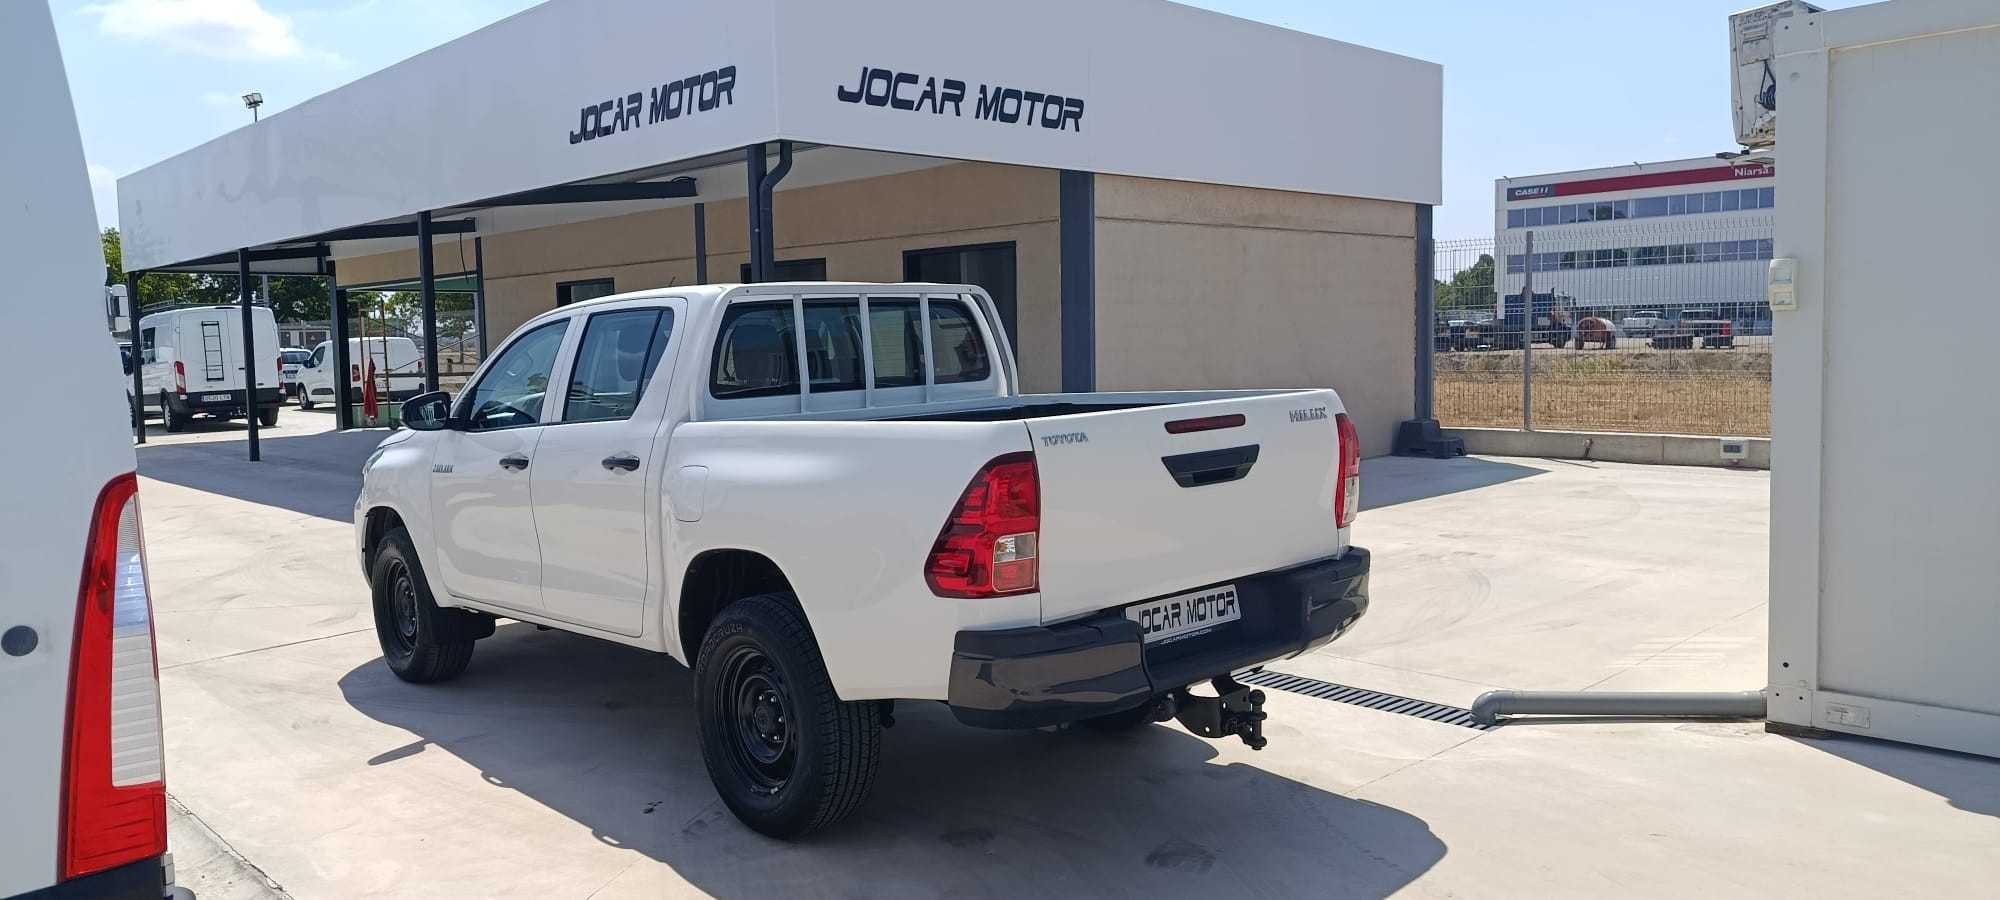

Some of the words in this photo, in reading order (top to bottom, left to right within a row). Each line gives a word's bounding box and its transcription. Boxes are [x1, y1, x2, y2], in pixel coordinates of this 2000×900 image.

[569, 91, 643, 145] JOCAR
[648, 65, 737, 125] MOTOR
[837, 66, 967, 117] JOCAR
[974, 84, 1085, 132] MOTOR
[1734, 167, 1769, 177] Niarsa
[1289, 406, 1328, 422] HILUX
[1041, 432, 1088, 447] TOYOTA
[1187, 590, 1236, 625] MOTOR
